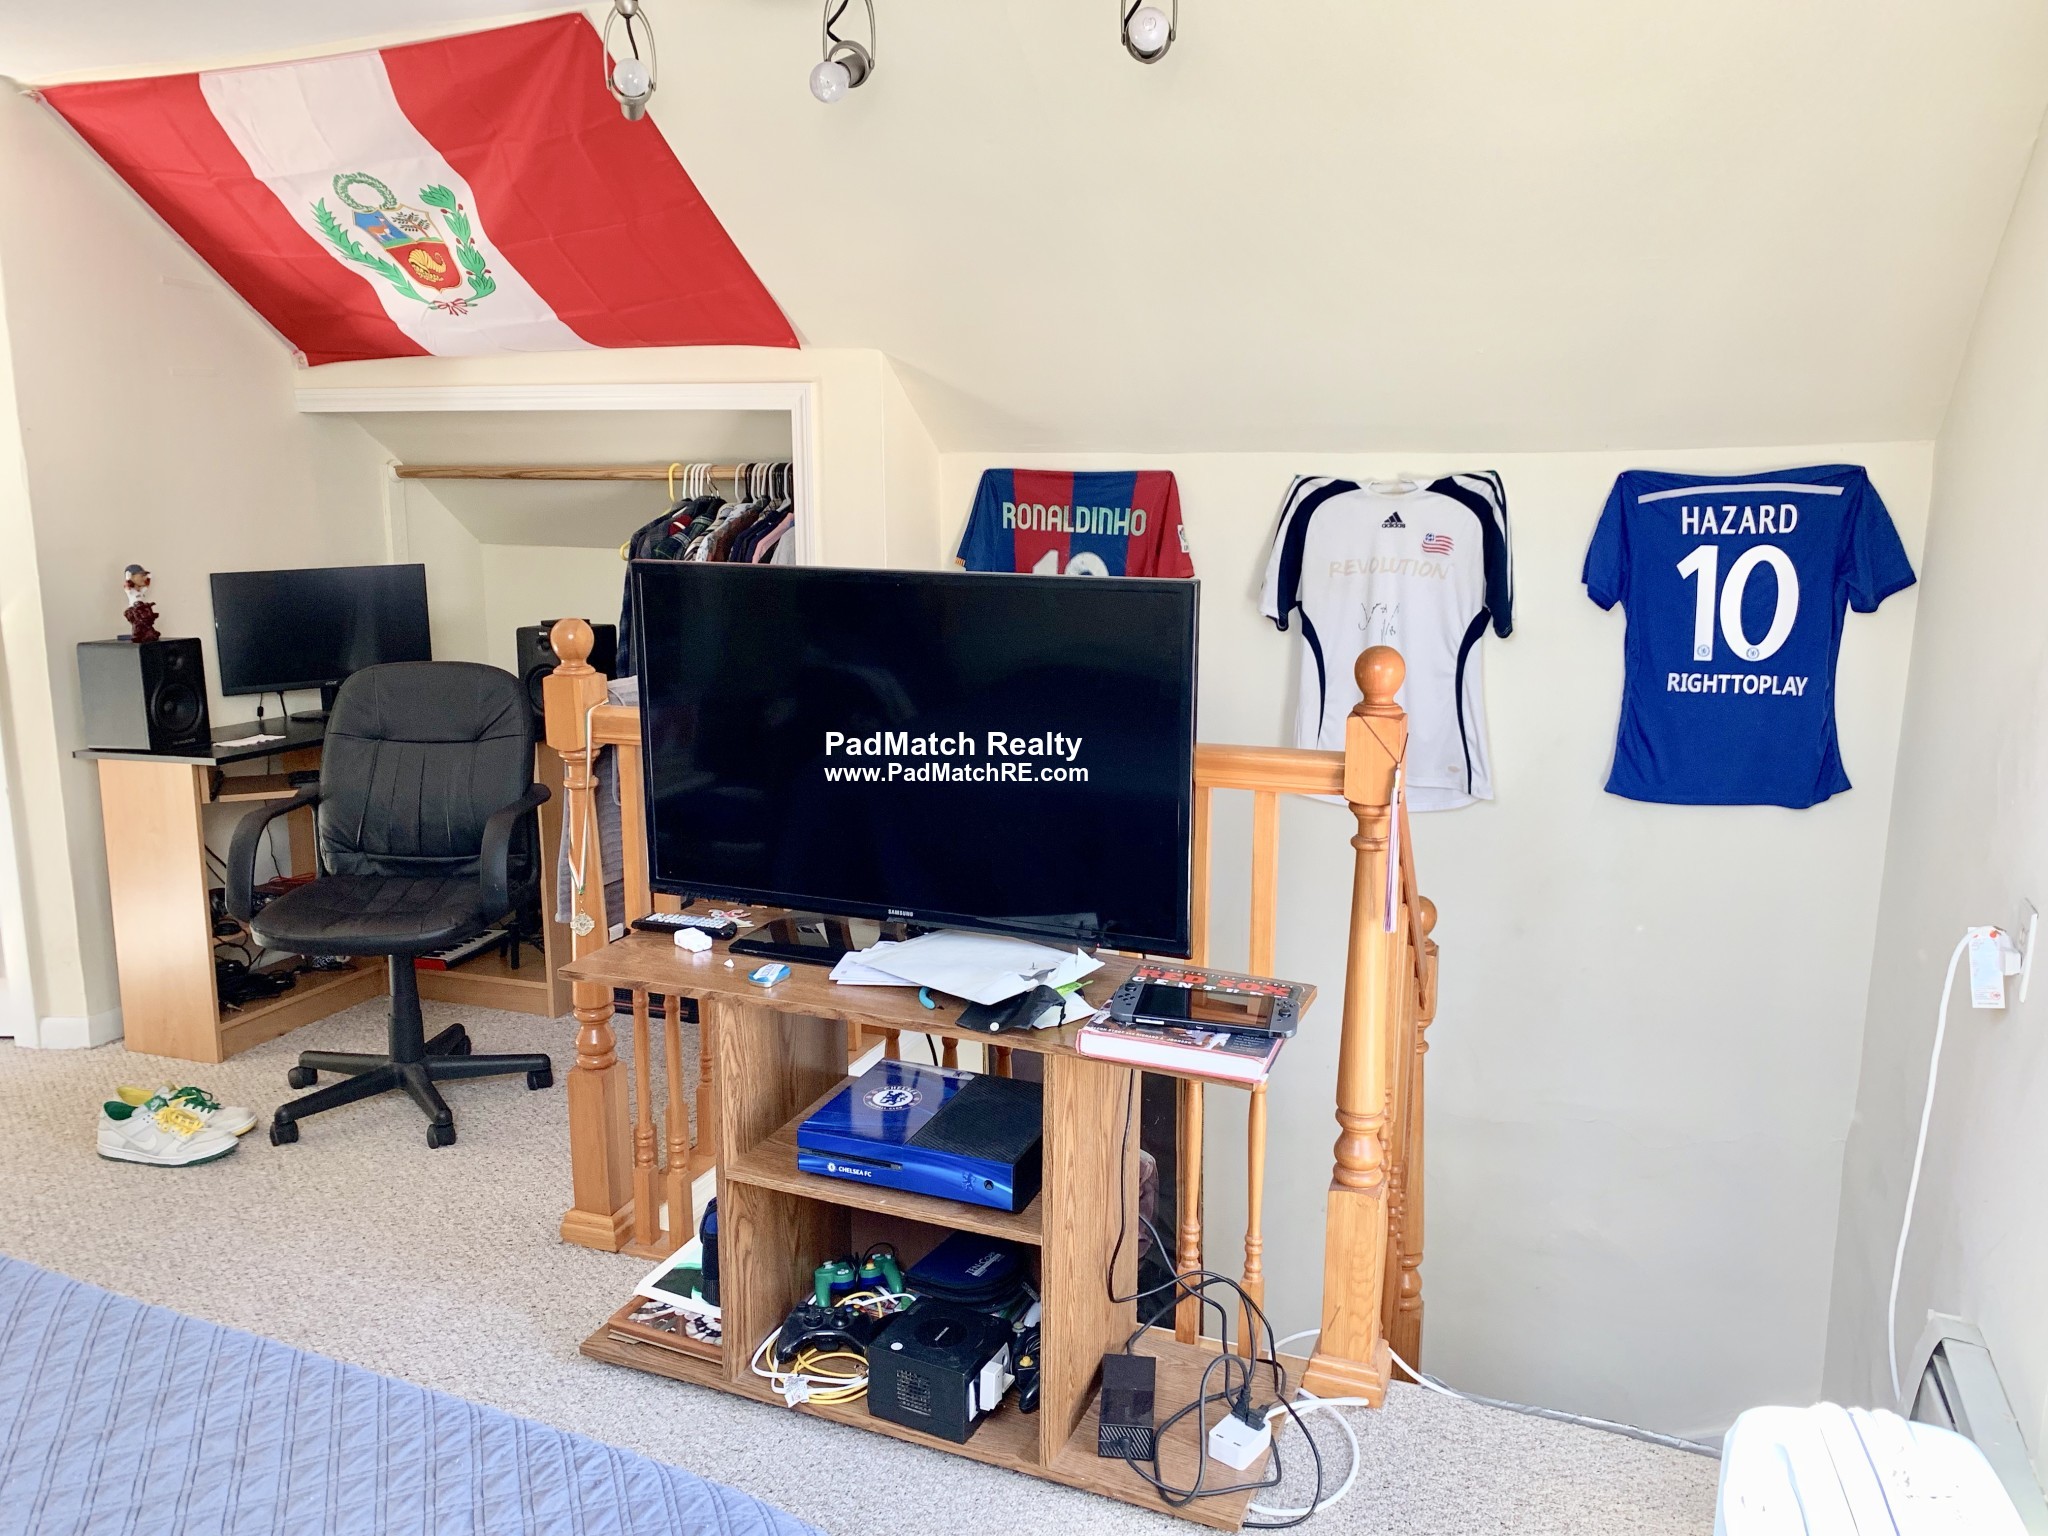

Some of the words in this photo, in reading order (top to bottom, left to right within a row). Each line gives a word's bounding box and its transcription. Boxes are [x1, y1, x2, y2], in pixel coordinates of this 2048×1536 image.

[1002, 501, 1147, 537] RONALDINHO
[1681, 503, 1799, 535] HAZARD
[1328, 556, 1450, 580] REVOLUTION
[1676, 544, 1800, 662] 10
[1667, 672, 1809, 697] RIGHTTOPLAY
[888, 908, 914, 917] SAMSUNG
[1136, 968, 1207, 984] RED
[1216, 979, 1292, 997] SOX
[838, 1166, 864, 1176] CHELSEA
